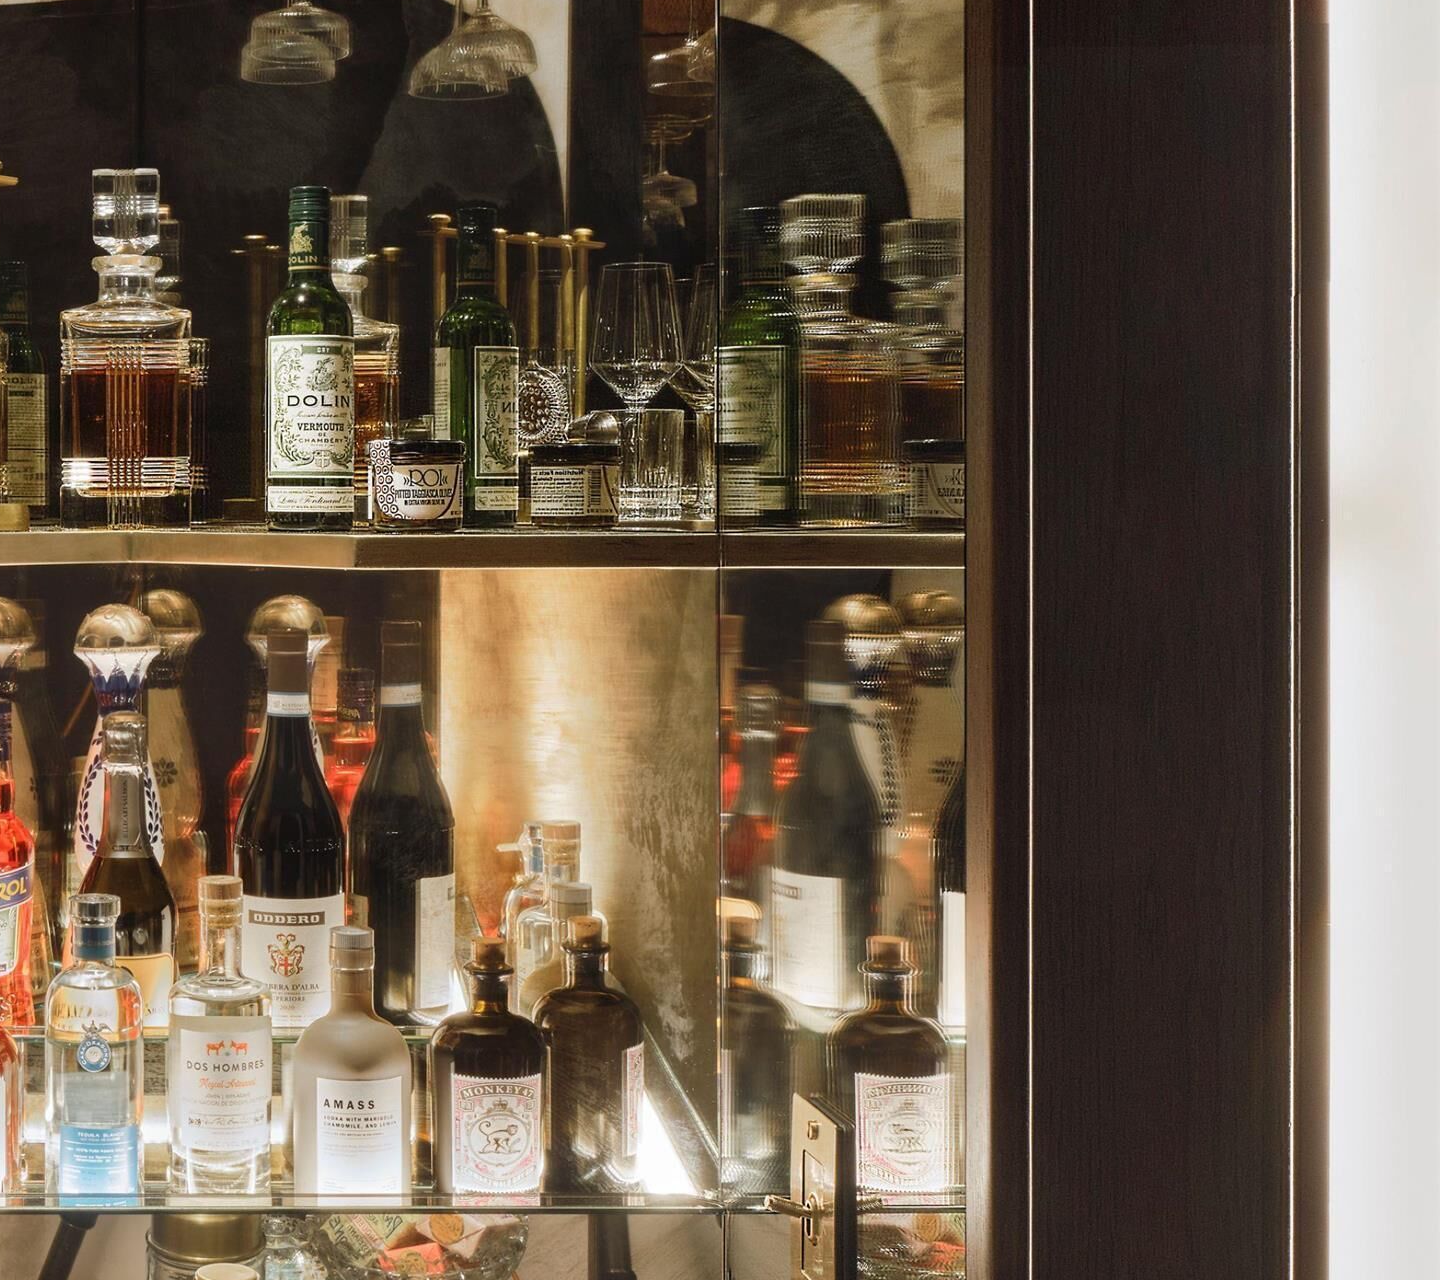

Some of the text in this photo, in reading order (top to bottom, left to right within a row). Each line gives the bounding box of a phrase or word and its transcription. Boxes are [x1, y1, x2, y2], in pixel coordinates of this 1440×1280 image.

[287, 395, 350, 407] DOLIN
[297, 422, 345, 431] VERMOUTH
[254, 913, 320, 924] ODDERO
[291, 983, 320, 991] D'ALBA
[187, 1059, 264, 1072] DOS HOMBRES
[462, 1085, 534, 1099] MONKEY 47
[323, 1098, 375, 1110] AMASS
